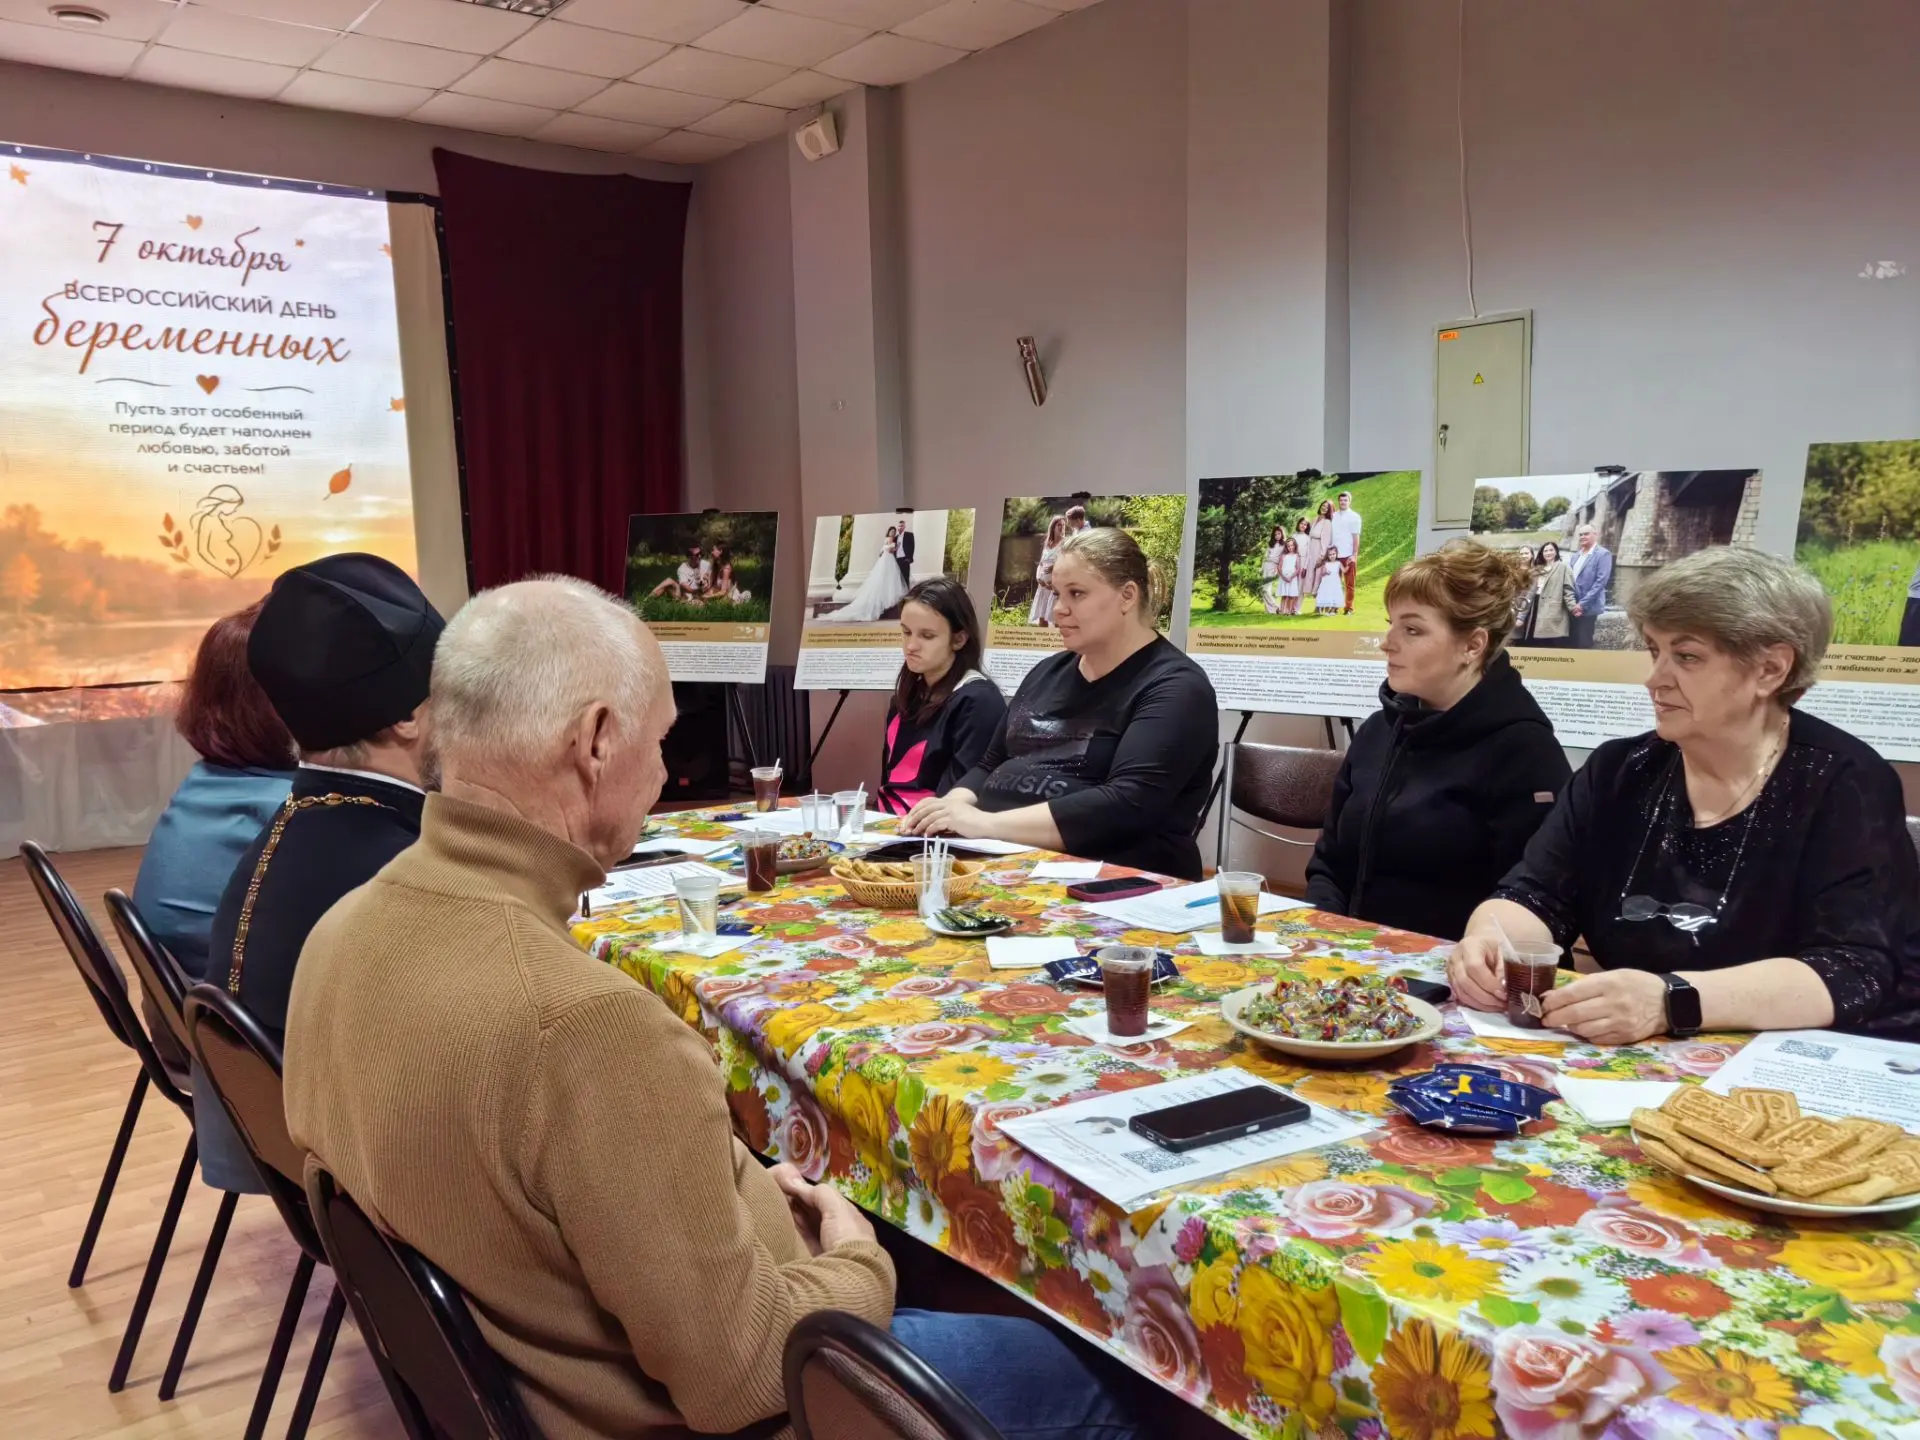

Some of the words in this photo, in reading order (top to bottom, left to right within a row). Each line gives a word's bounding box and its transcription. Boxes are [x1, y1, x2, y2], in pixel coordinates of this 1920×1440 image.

[92, 220, 124, 263] 7
[138, 226, 292, 287] октября
[64, 283, 273, 315] ВСЕРОССИЙСКИЙ
[279, 300, 337, 319] ДЕНЬ
[32, 279, 351, 375] беременных
[115, 401, 166, 416] Пусть
[170, 404, 208, 417] этот
[211, 407, 304, 420] особенный
[109, 423, 175, 437] период
[179, 423, 227, 438] будет
[232, 426, 312, 439] наполнен
[137, 441, 219, 456] любовью,
[223, 442, 291, 457] заботой
[167, 463, 179, 473] и
[183, 463, 266, 475] счастьем!
[1520, 655, 1576, 663] превратились
[1844, 654, 1887, 662] счастье
[1835, 663, 1885, 673] любимого
